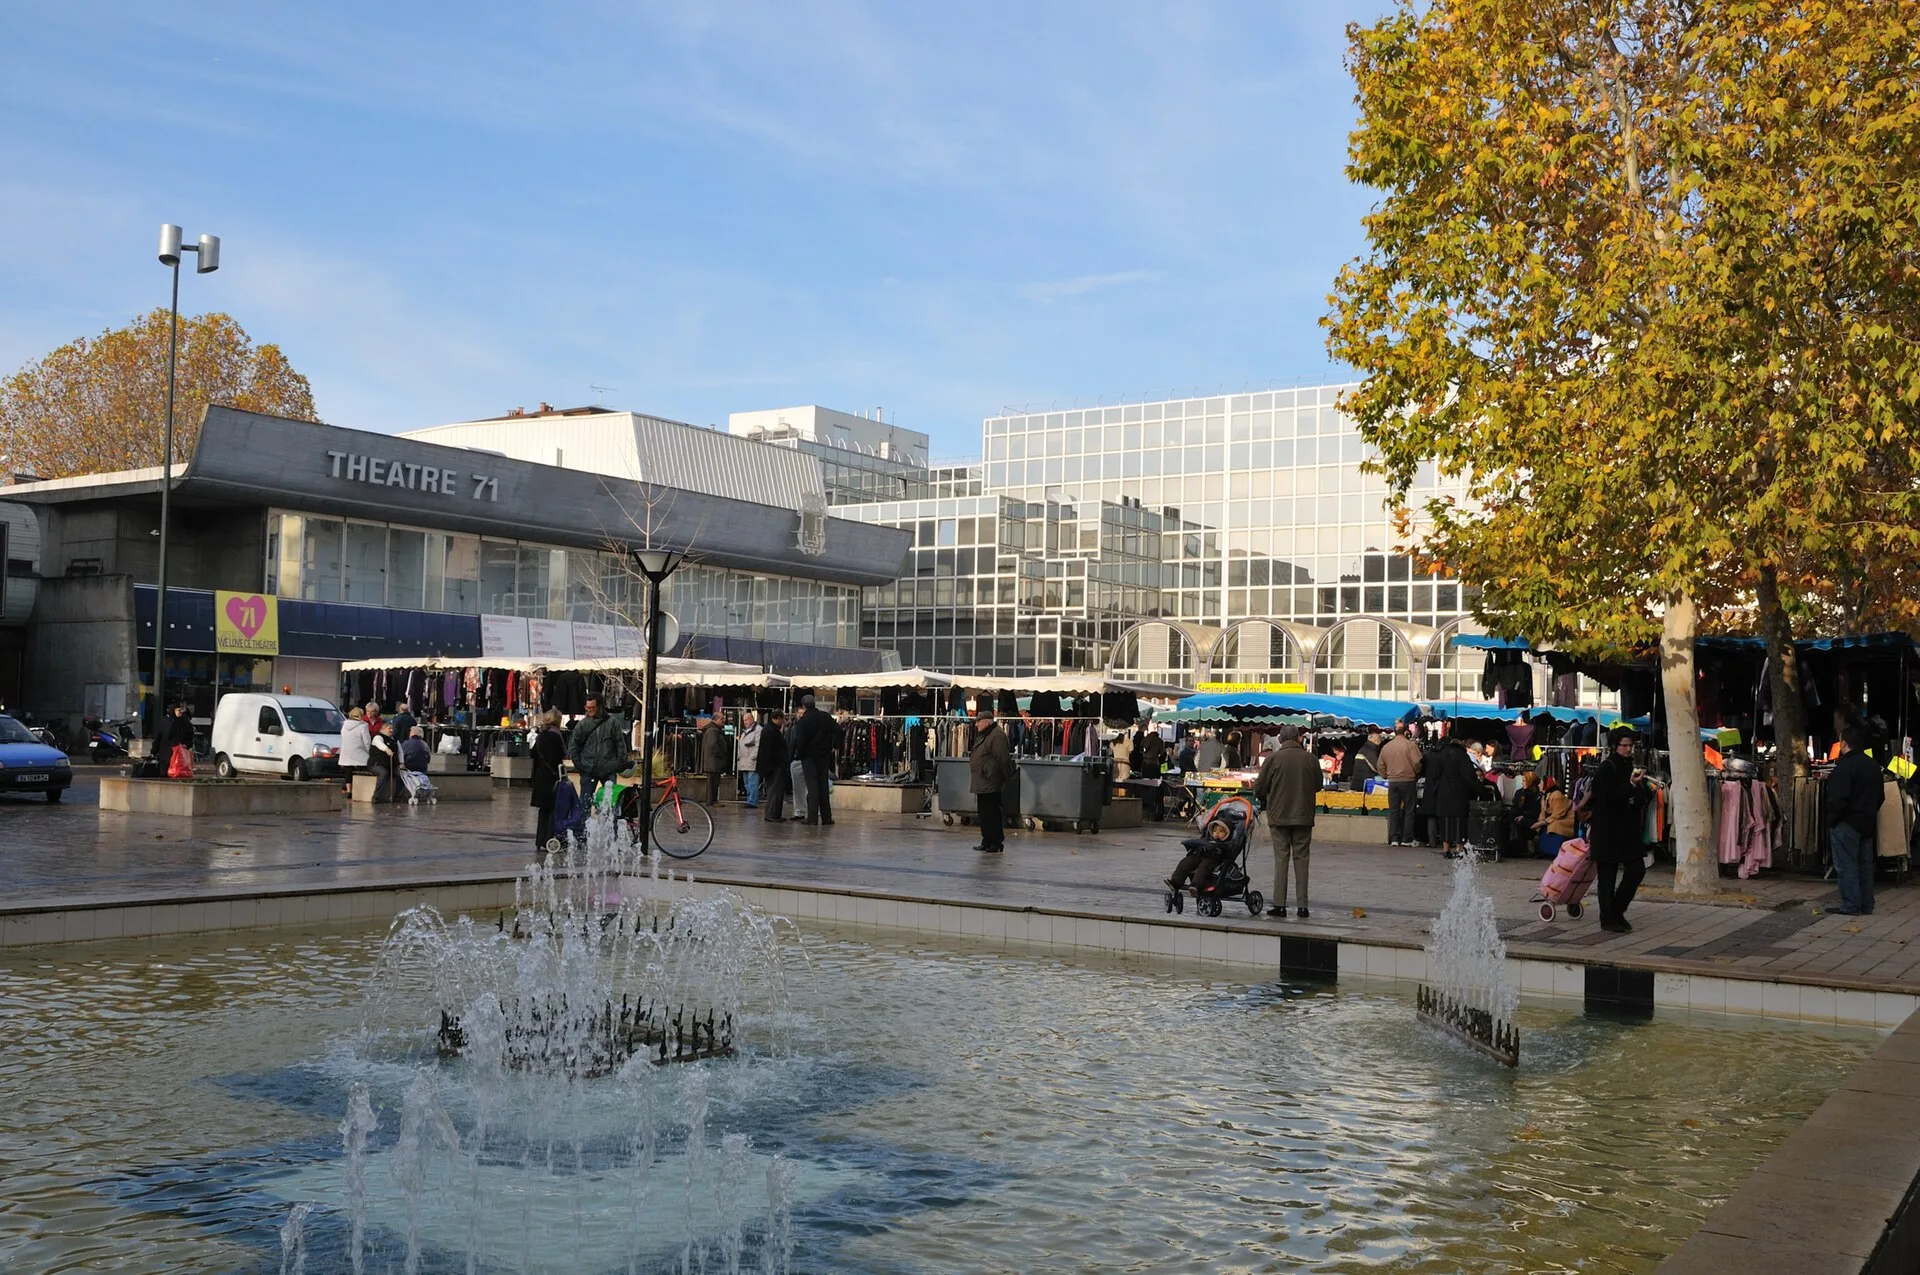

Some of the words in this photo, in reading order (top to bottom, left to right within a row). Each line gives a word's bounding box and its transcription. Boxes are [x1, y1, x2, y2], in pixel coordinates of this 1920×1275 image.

[327, 450, 457, 496] THEATRE
[472, 474, 499, 502] 71
[239, 606, 256, 629] 71
[218, 637, 229, 647] WE
[229, 638, 243, 648] LOVE
[244, 639, 252, 648] CE
[1198, 684, 1223, 693] Semaine
[1224, 684, 1232, 693] de
